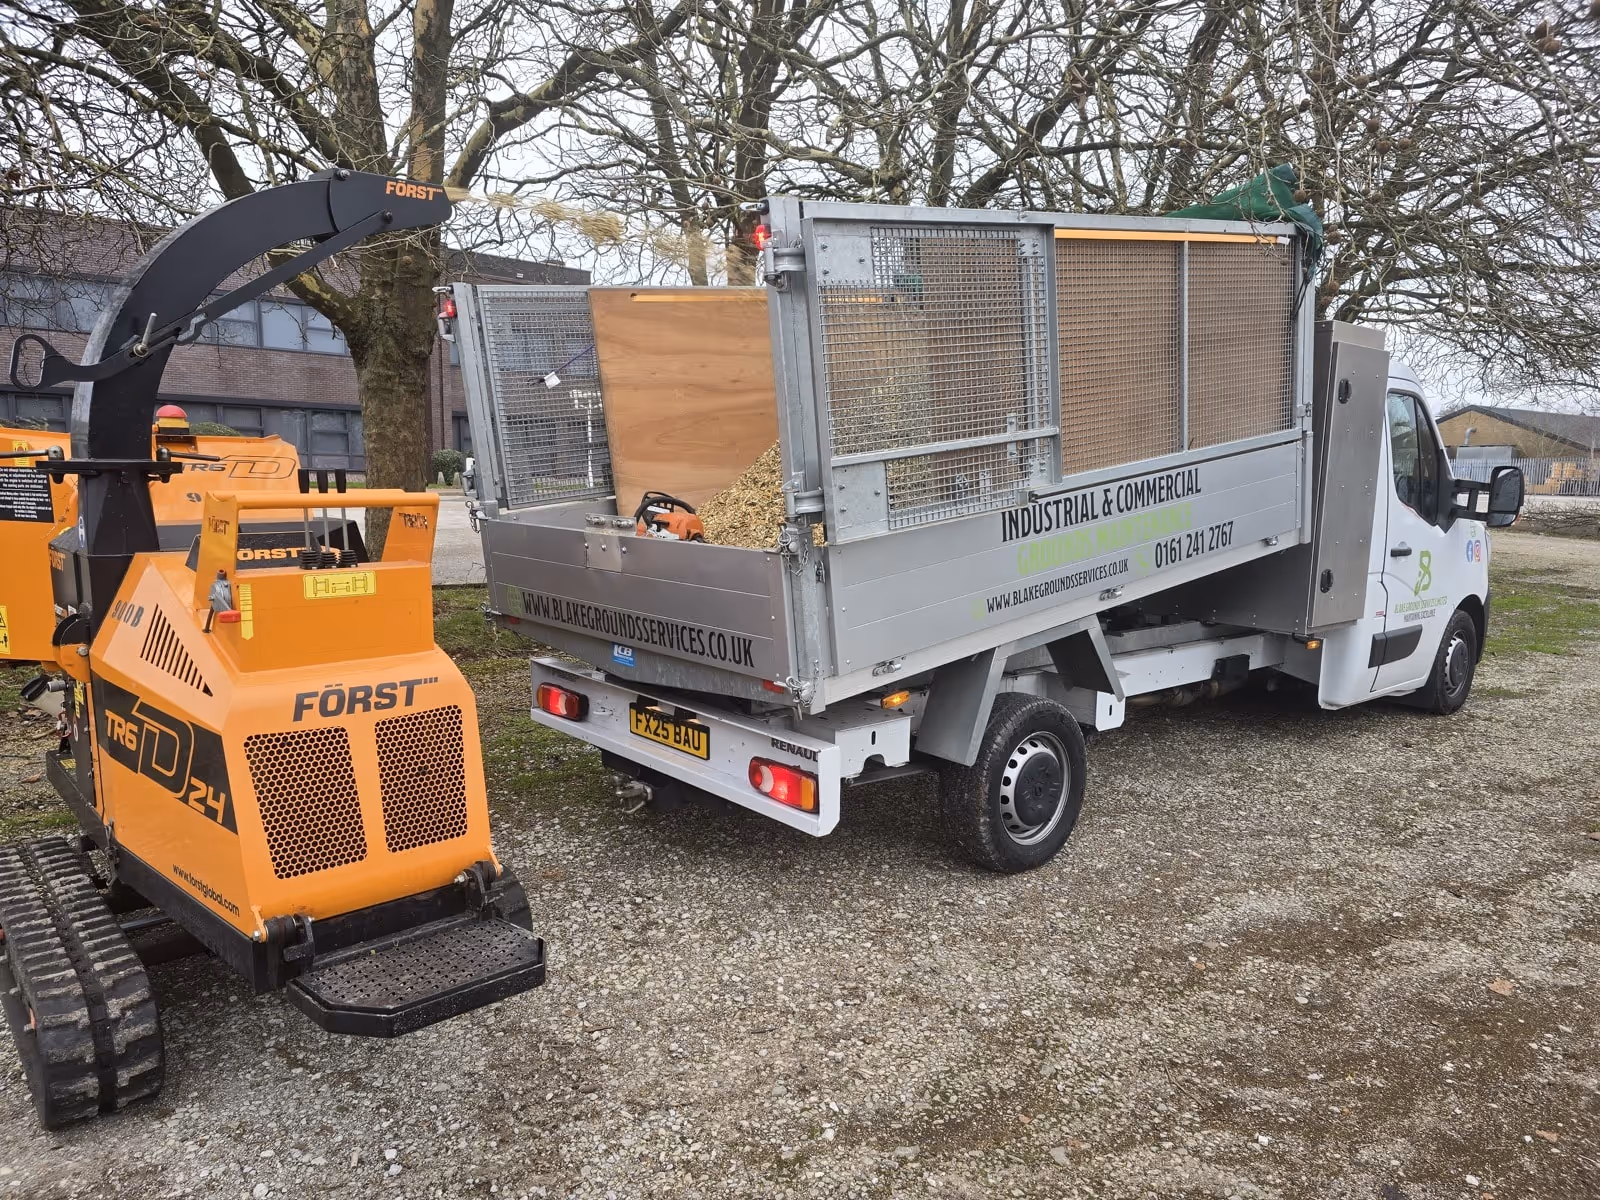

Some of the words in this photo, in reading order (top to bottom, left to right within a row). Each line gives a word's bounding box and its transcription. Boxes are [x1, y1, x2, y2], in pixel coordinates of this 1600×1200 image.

[385, 180, 442, 201] FÖRST
[1001, 490, 1099, 543] INDUSTRIAL
[1102, 487, 1114, 517] &
[1116, 467, 1202, 514] COMMERCIAL
[236, 547, 310, 561] ÖRST
[1016, 528, 1094, 576] GROUNDS
[1099, 501, 1193, 551] MAINTENANCE
[1154, 537, 1183, 569] 0161
[1186, 529, 1205, 559] 241
[1208, 521, 1234, 551] 2767
[986, 558, 1129, 614] WWW.BLAKEGROUNDSSERVICES.CO.UK
[522, 591, 756, 668] WWW.BLAKEGROUNDSSERVICES.CO.UK
[292, 677, 438, 723] FÖRST
[634, 711, 670, 741] FX25
[673, 724, 702, 752] BAU
[105, 709, 138, 752] TR6
[188, 776, 226, 825] 24
[172, 863, 240, 918] www.forstglobal.com
